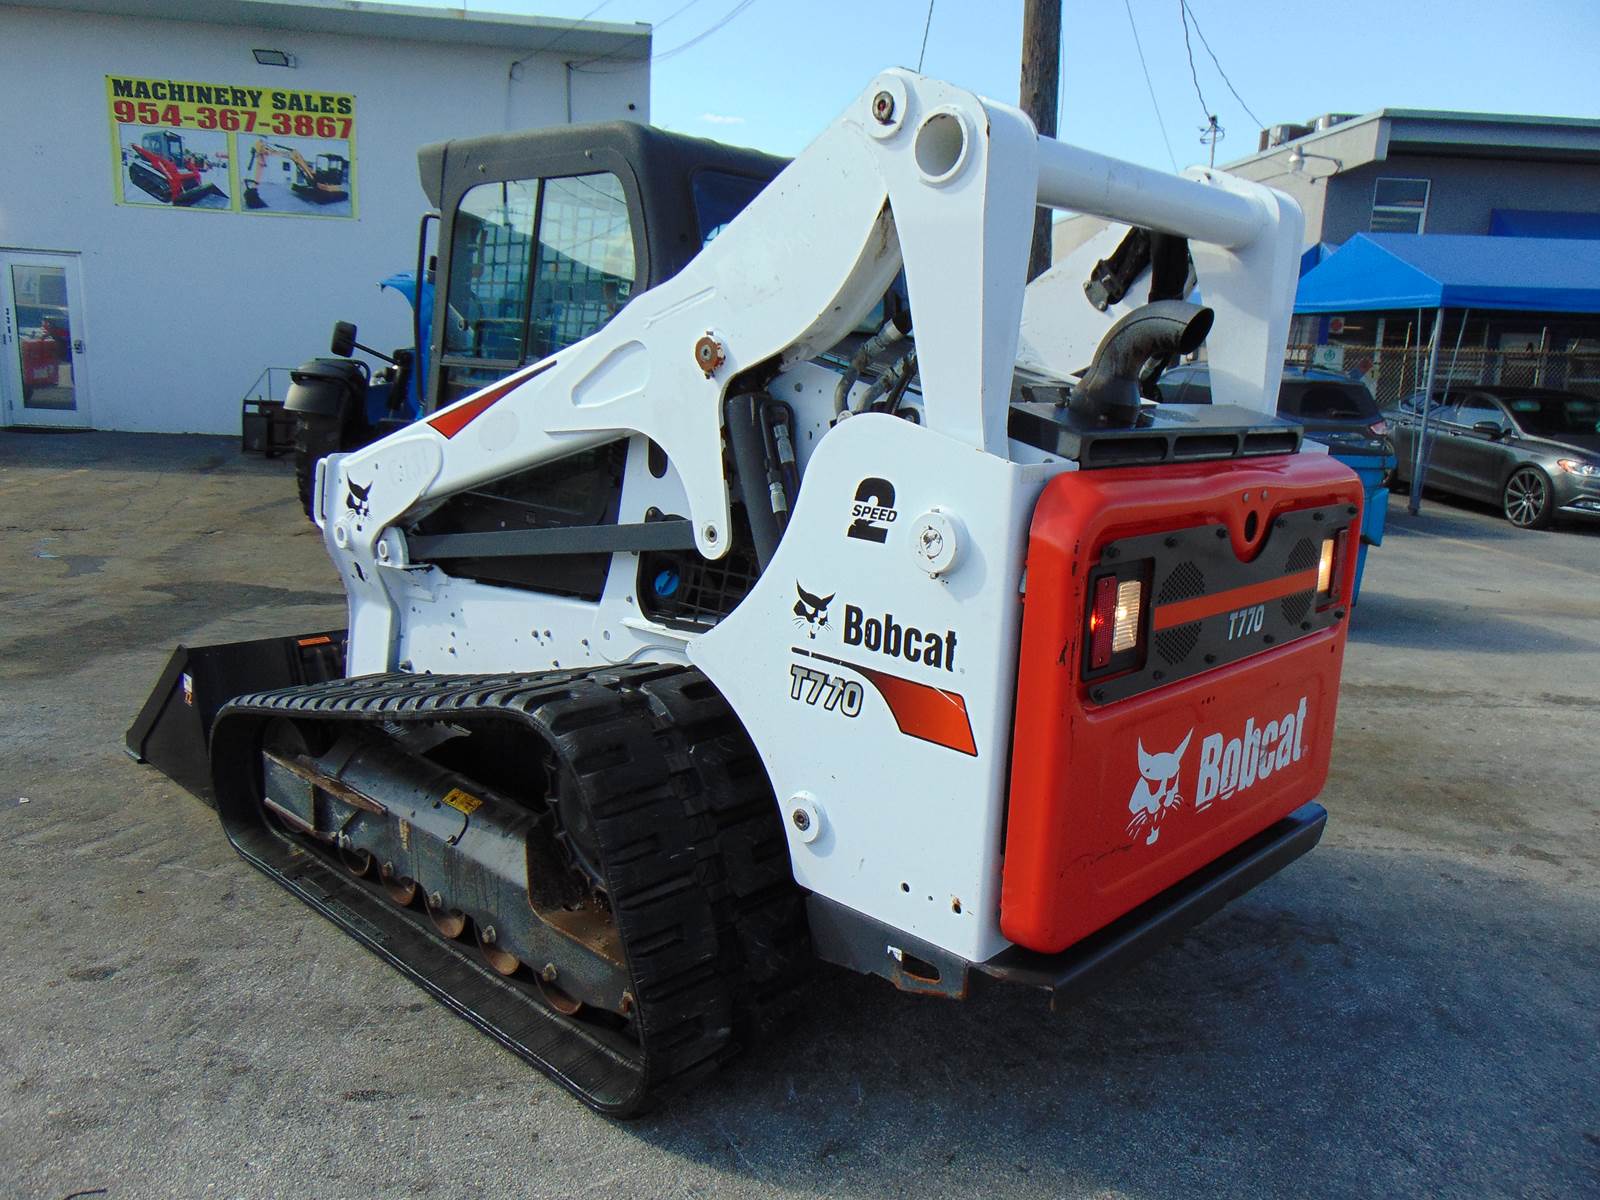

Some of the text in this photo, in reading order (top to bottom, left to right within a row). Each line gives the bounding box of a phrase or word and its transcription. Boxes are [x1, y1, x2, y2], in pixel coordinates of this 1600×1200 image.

[111, 78, 352, 114] MACHINERY SALES
[113, 99, 353, 139] 954-367-3867
[847, 477, 896, 544] 2
[852, 504, 898, 523] SPEED
[843, 604, 957, 672] Bobcat
[1228, 604, 1265, 641] T770
[790, 663, 863, 718] T770
[1195, 696, 1307, 810] Bobcat
